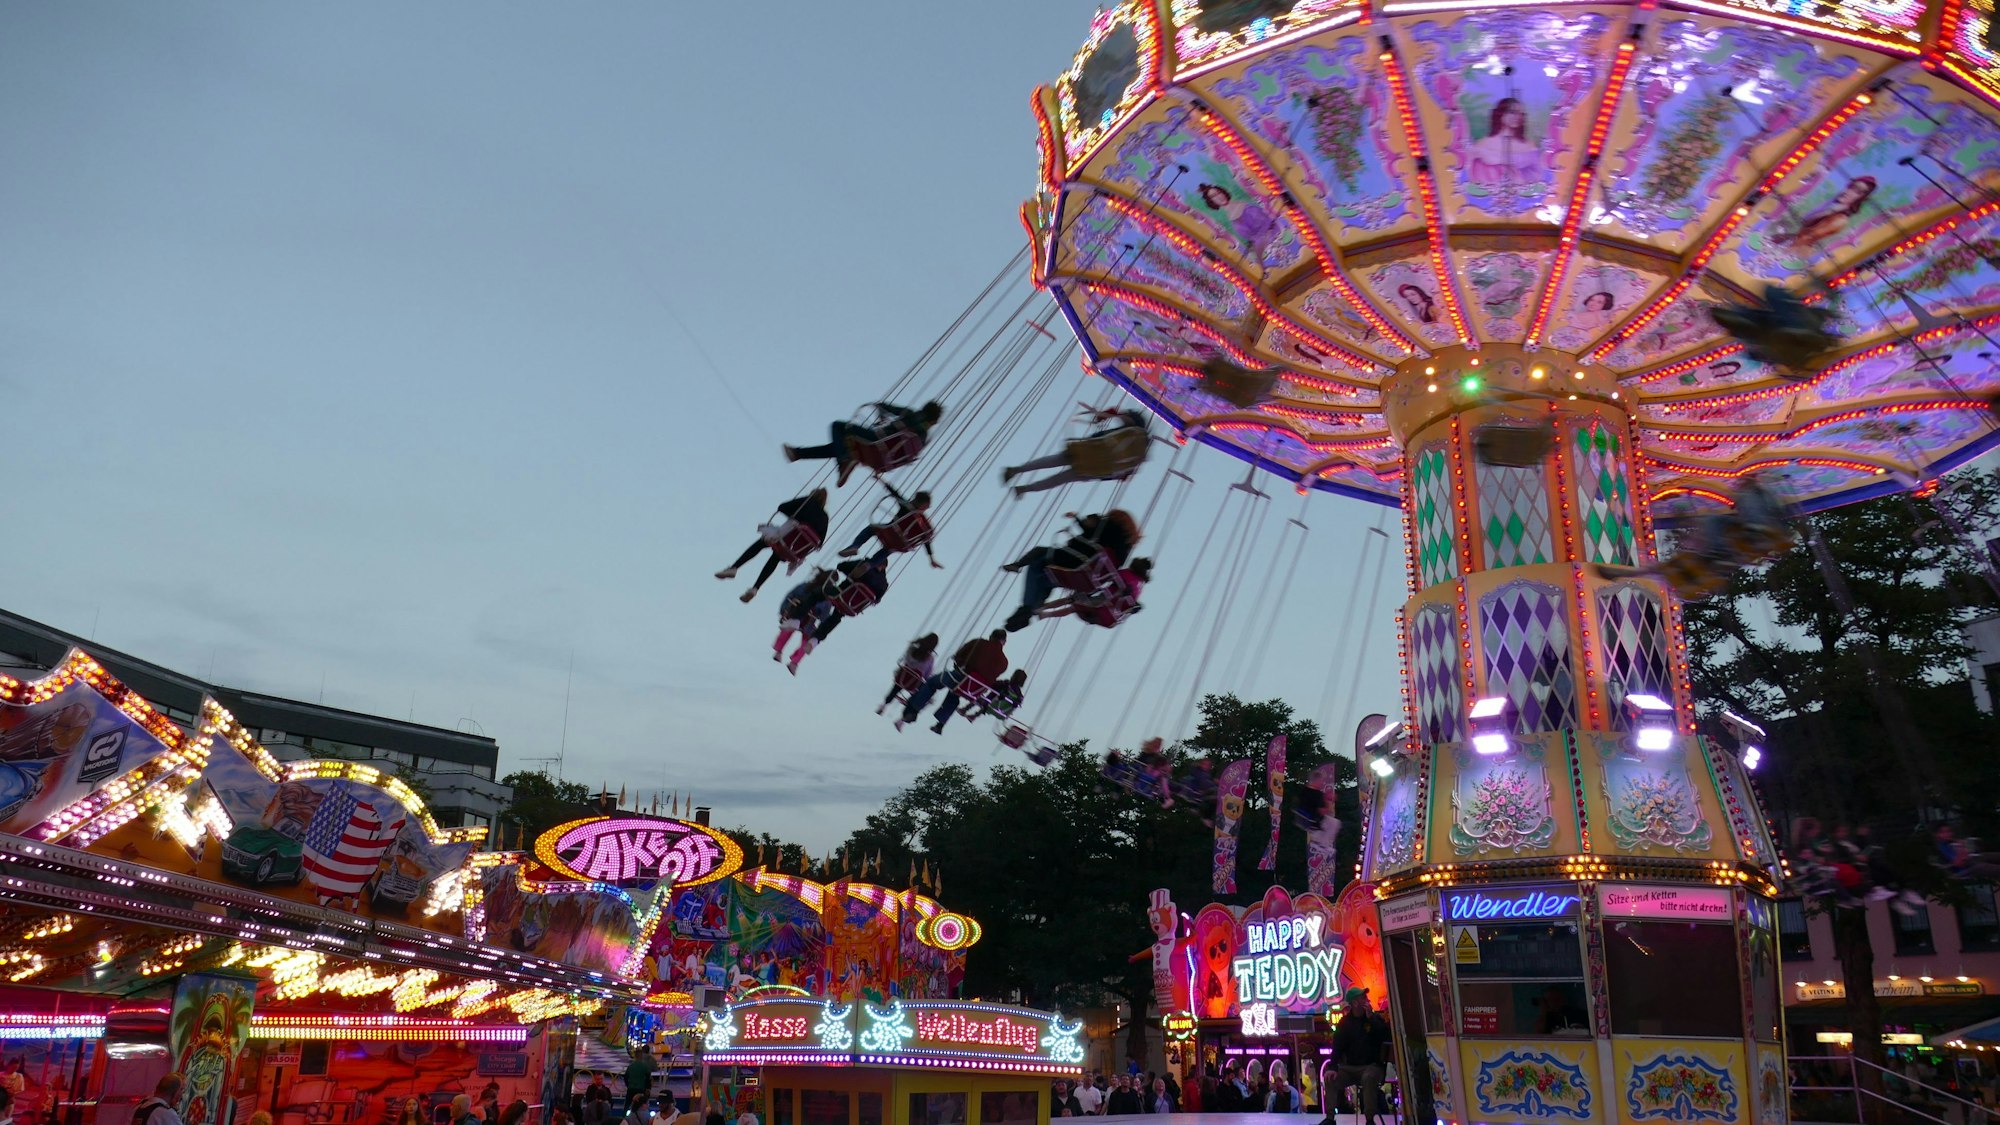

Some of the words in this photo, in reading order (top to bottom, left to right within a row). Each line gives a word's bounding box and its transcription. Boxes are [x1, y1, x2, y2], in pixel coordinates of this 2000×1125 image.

[658, 833, 719, 882] OFF
[1449, 891, 1583, 920] Wendler
[1607, 893, 1630, 905] Sitze
[1631, 891, 1649, 903] und
[1651, 890, 1677, 901] Ketten
[1660, 901, 1678, 911] bitte
[1678, 902, 1699, 912] nicht
[1248, 915, 1322, 954] HAPPY
[1234, 948, 1343, 1003] TEDDY
[1808, 988, 1835, 996] VELTINS
[1240, 1002, 1278, 1036] XXL
[1464, 1006, 1497, 1014] FAHRPREIS
[743, 1012, 807, 1040] Kasse
[917, 1011, 1038, 1053] Wellenflug
